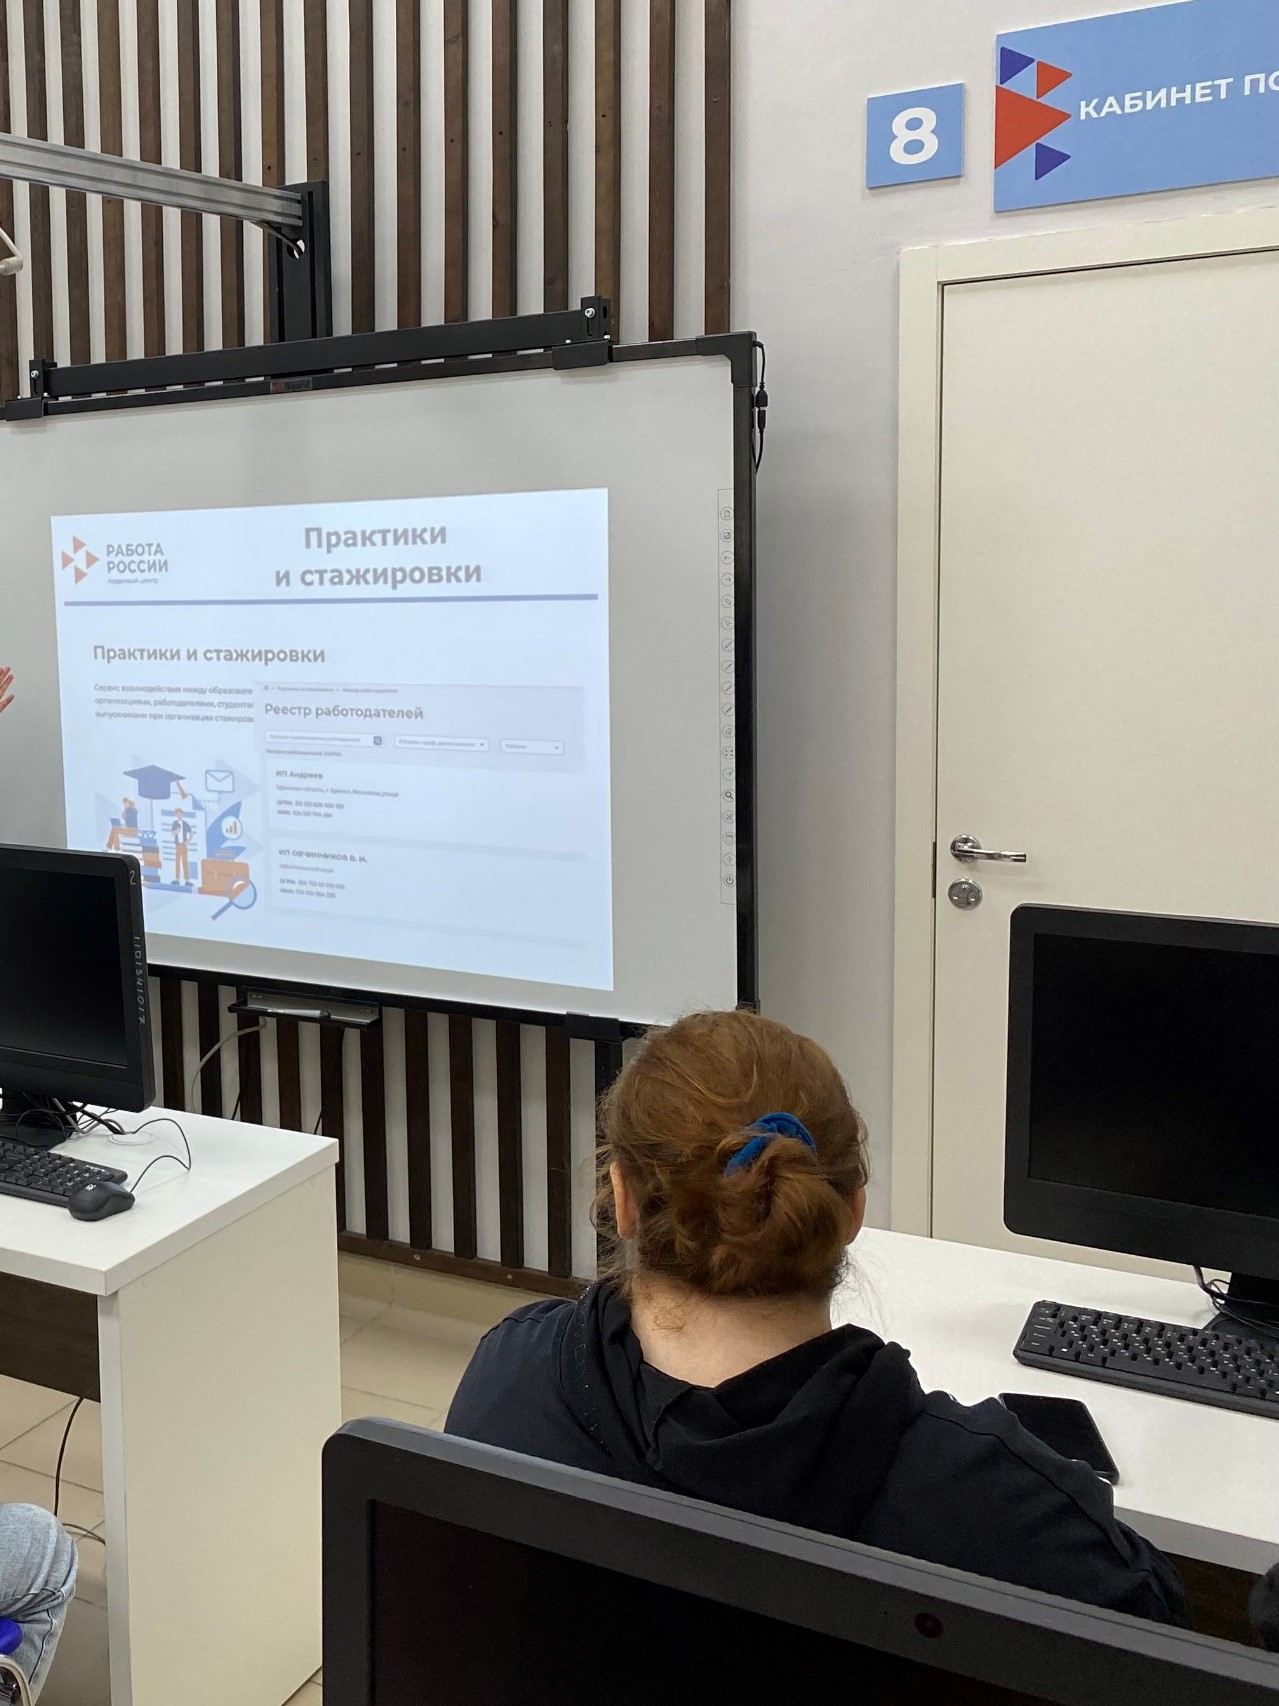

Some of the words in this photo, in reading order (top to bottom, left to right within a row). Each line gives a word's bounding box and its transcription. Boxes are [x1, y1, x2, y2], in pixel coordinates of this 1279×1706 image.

[1079, 77, 1234, 120] КАБИНЕТ
[888, 106, 939, 166] 8
[303, 523, 448, 553] Практики
[106, 542, 165, 557] РАБОТА
[107, 559, 169, 574] РОССИИ
[275, 569, 291, 588] и
[300, 564, 482, 590] стажировки
[93, 644, 181, 664] Практики
[186, 649, 198, 662] и
[203, 648, 326, 667] стажировки
[264, 703, 312, 719] Реестр
[315, 704, 425, 720] работодателей
[288, 770, 323, 781] Андреев
[129, 869, 137, 886] 2
